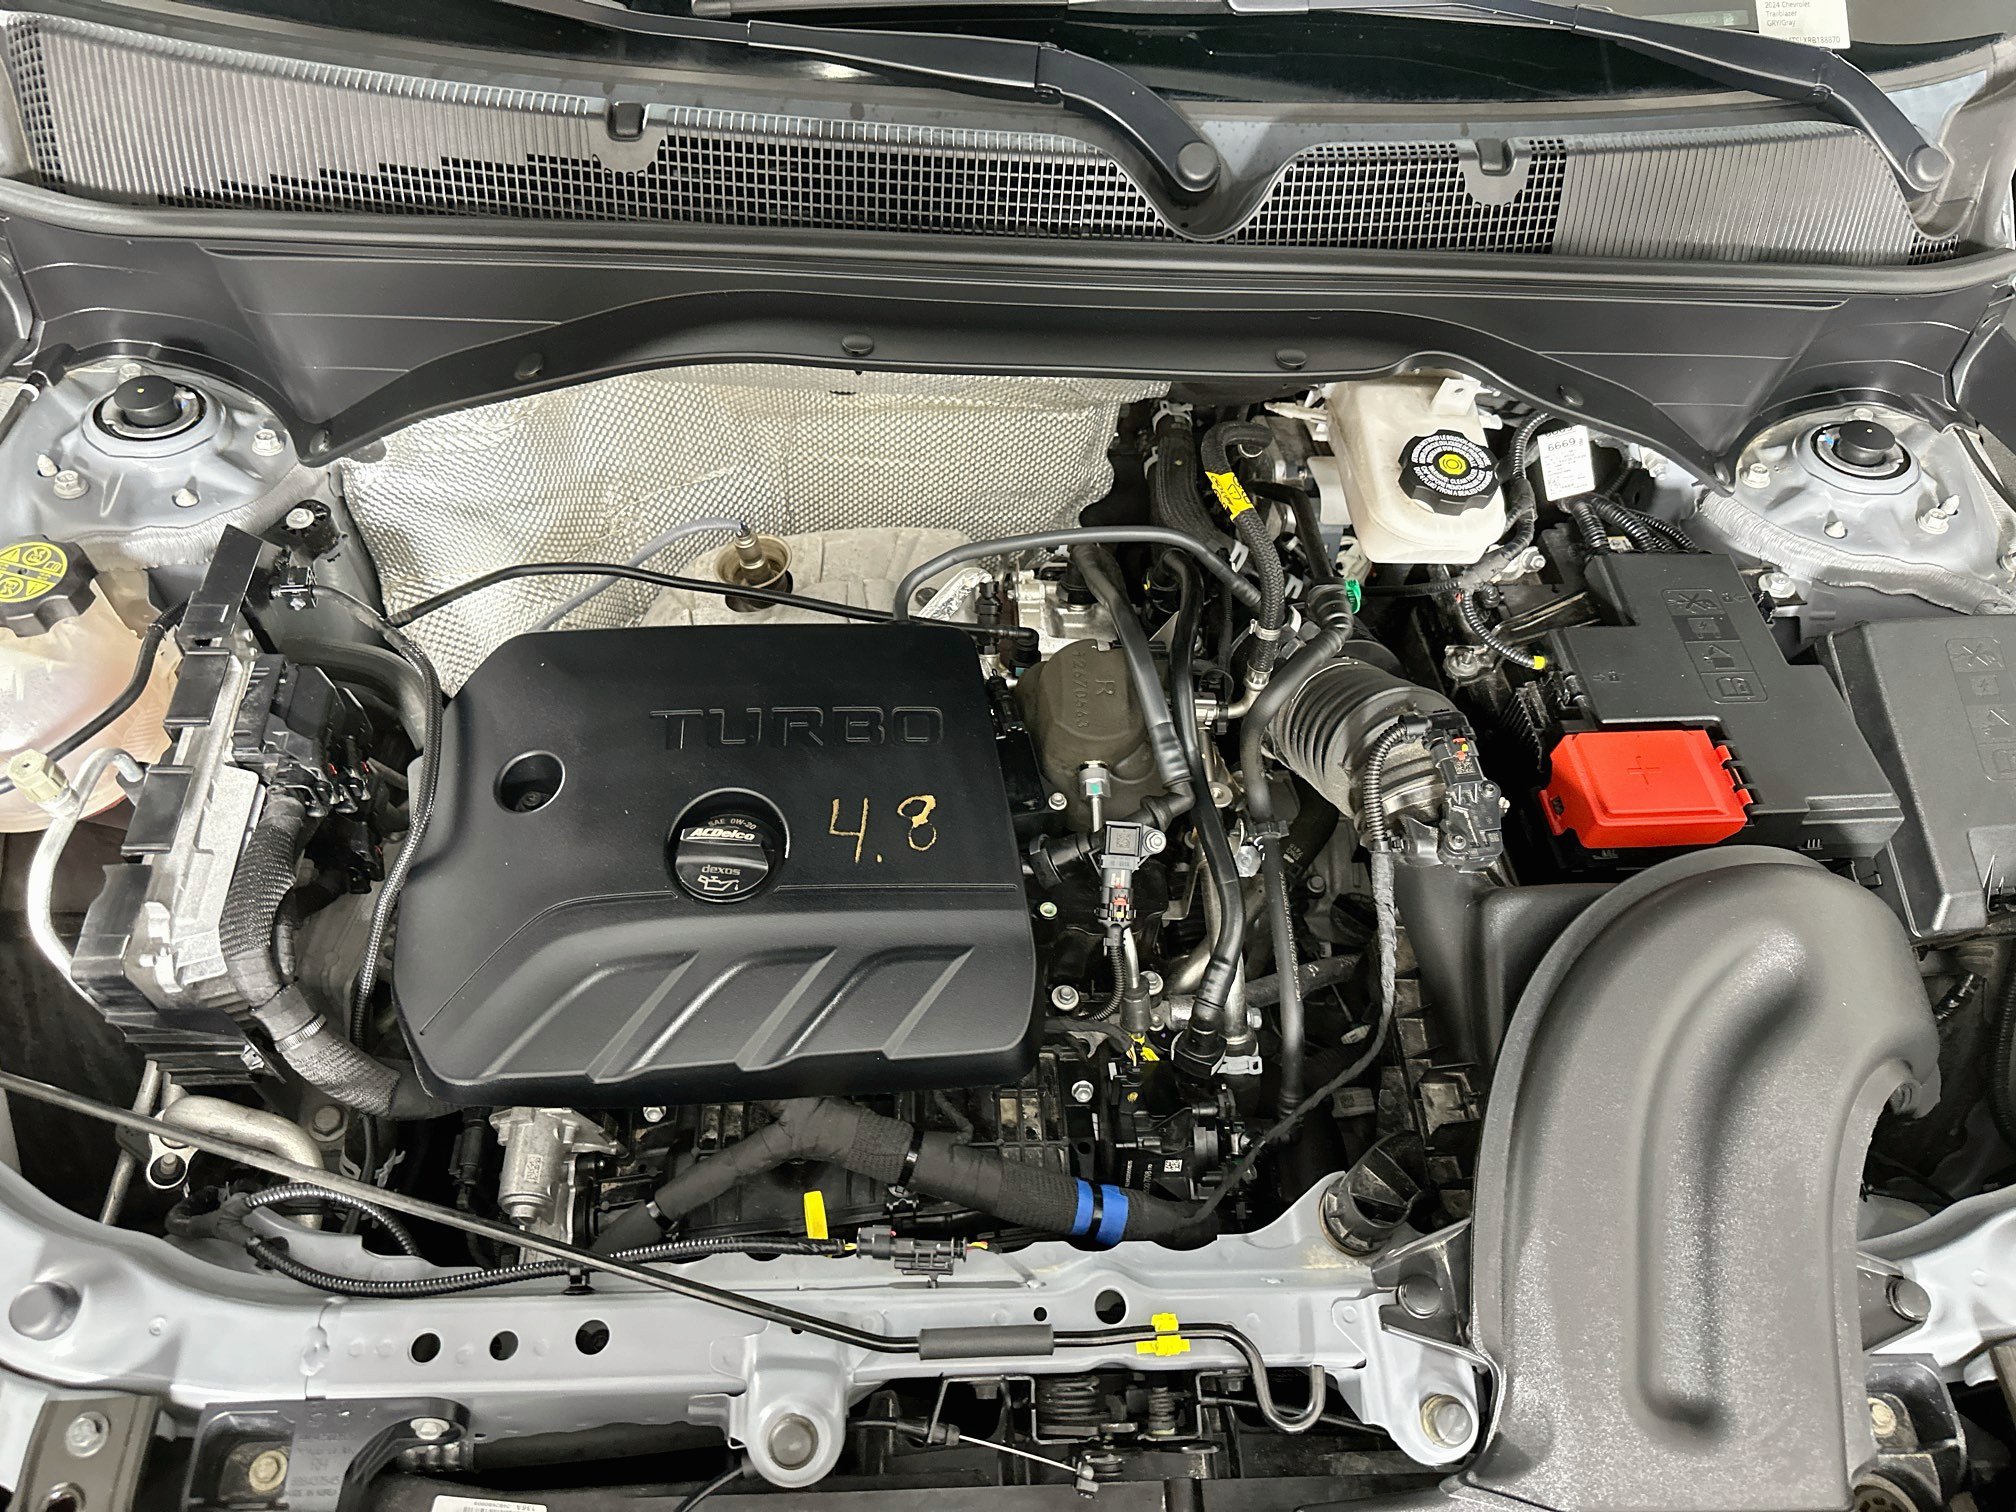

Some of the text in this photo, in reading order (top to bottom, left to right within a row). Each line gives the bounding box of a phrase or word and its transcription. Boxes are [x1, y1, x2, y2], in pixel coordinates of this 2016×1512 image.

[1420, 477, 1437, 489] FLUID
[1435, 485, 1452, 495] FROM
[650, 706, 943, 750] TURBO
[708, 818, 757, 830] SAE 0W-20
[828, 794, 938, 864] 4.8
[690, 828, 755, 840] ACDelco
[702, 864, 741, 875] dexos
